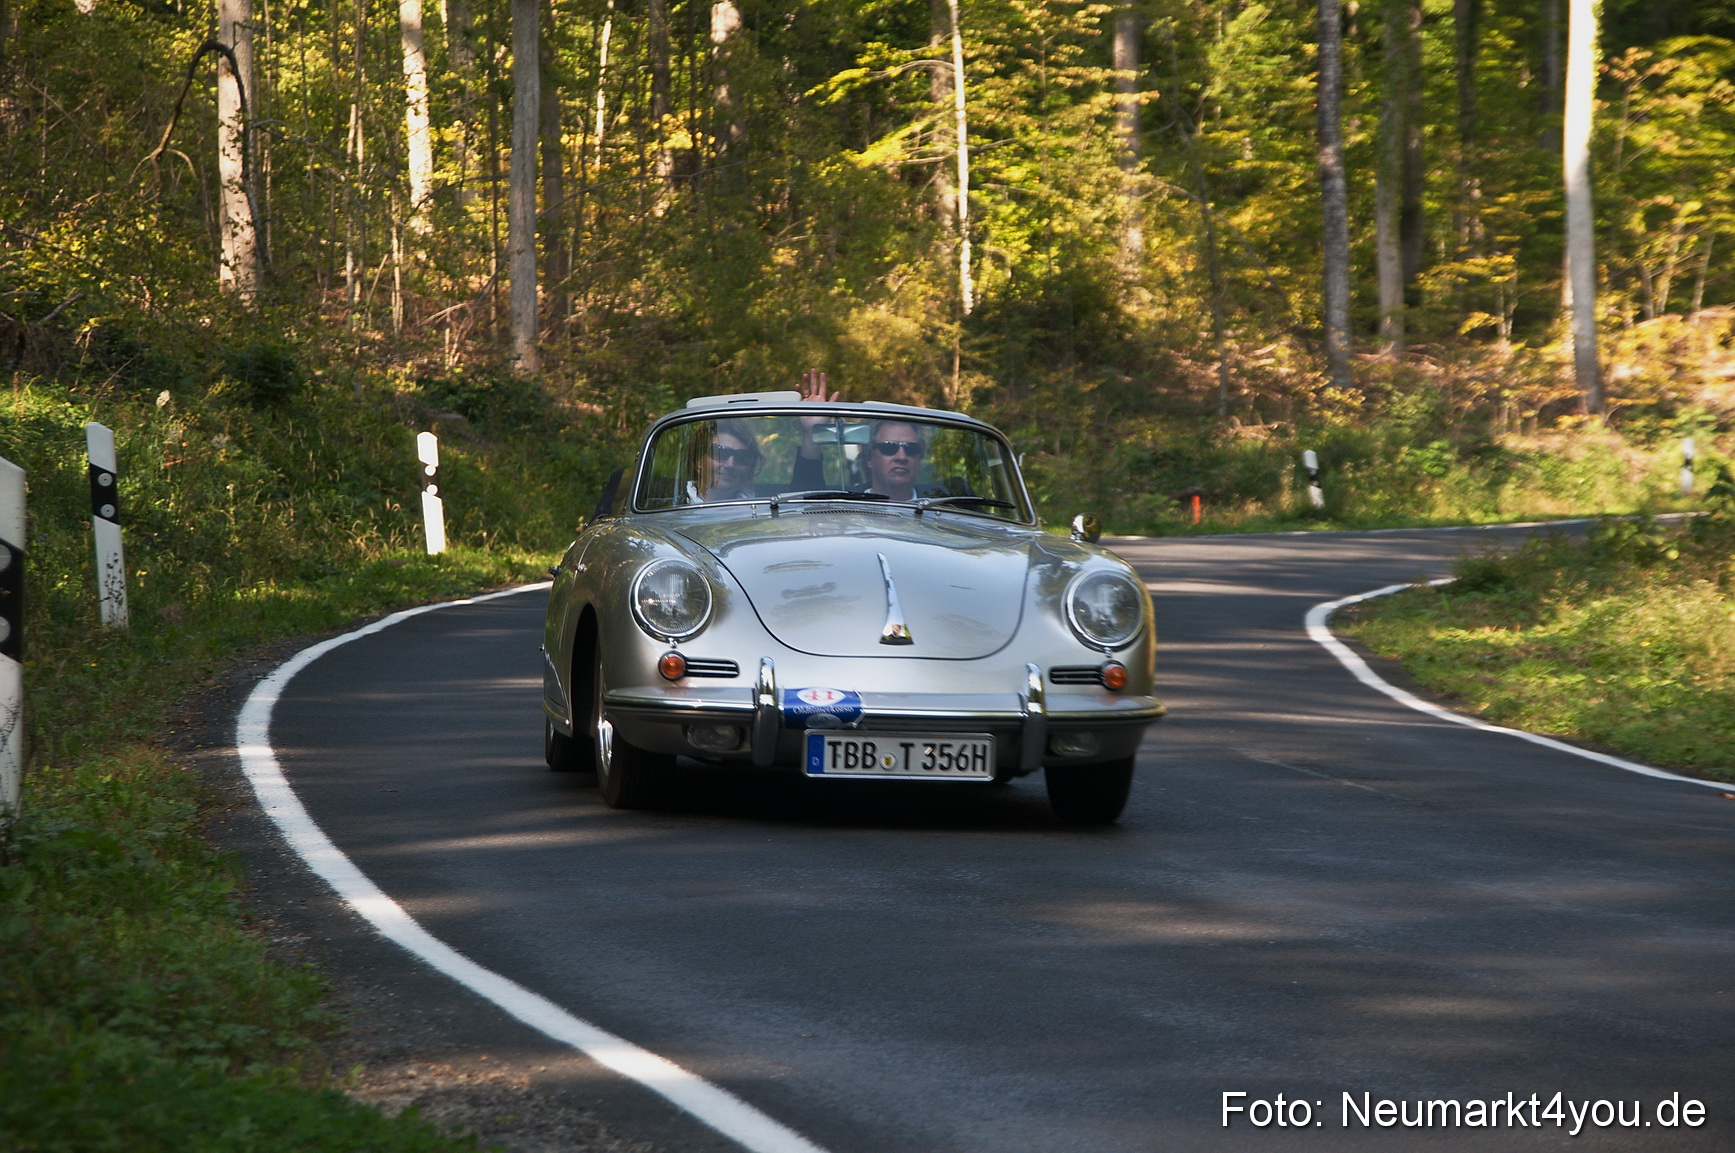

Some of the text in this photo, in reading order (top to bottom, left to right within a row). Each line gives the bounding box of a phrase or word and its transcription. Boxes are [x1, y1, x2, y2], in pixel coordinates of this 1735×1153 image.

[827, 741, 988, 772] TBB T 356H
